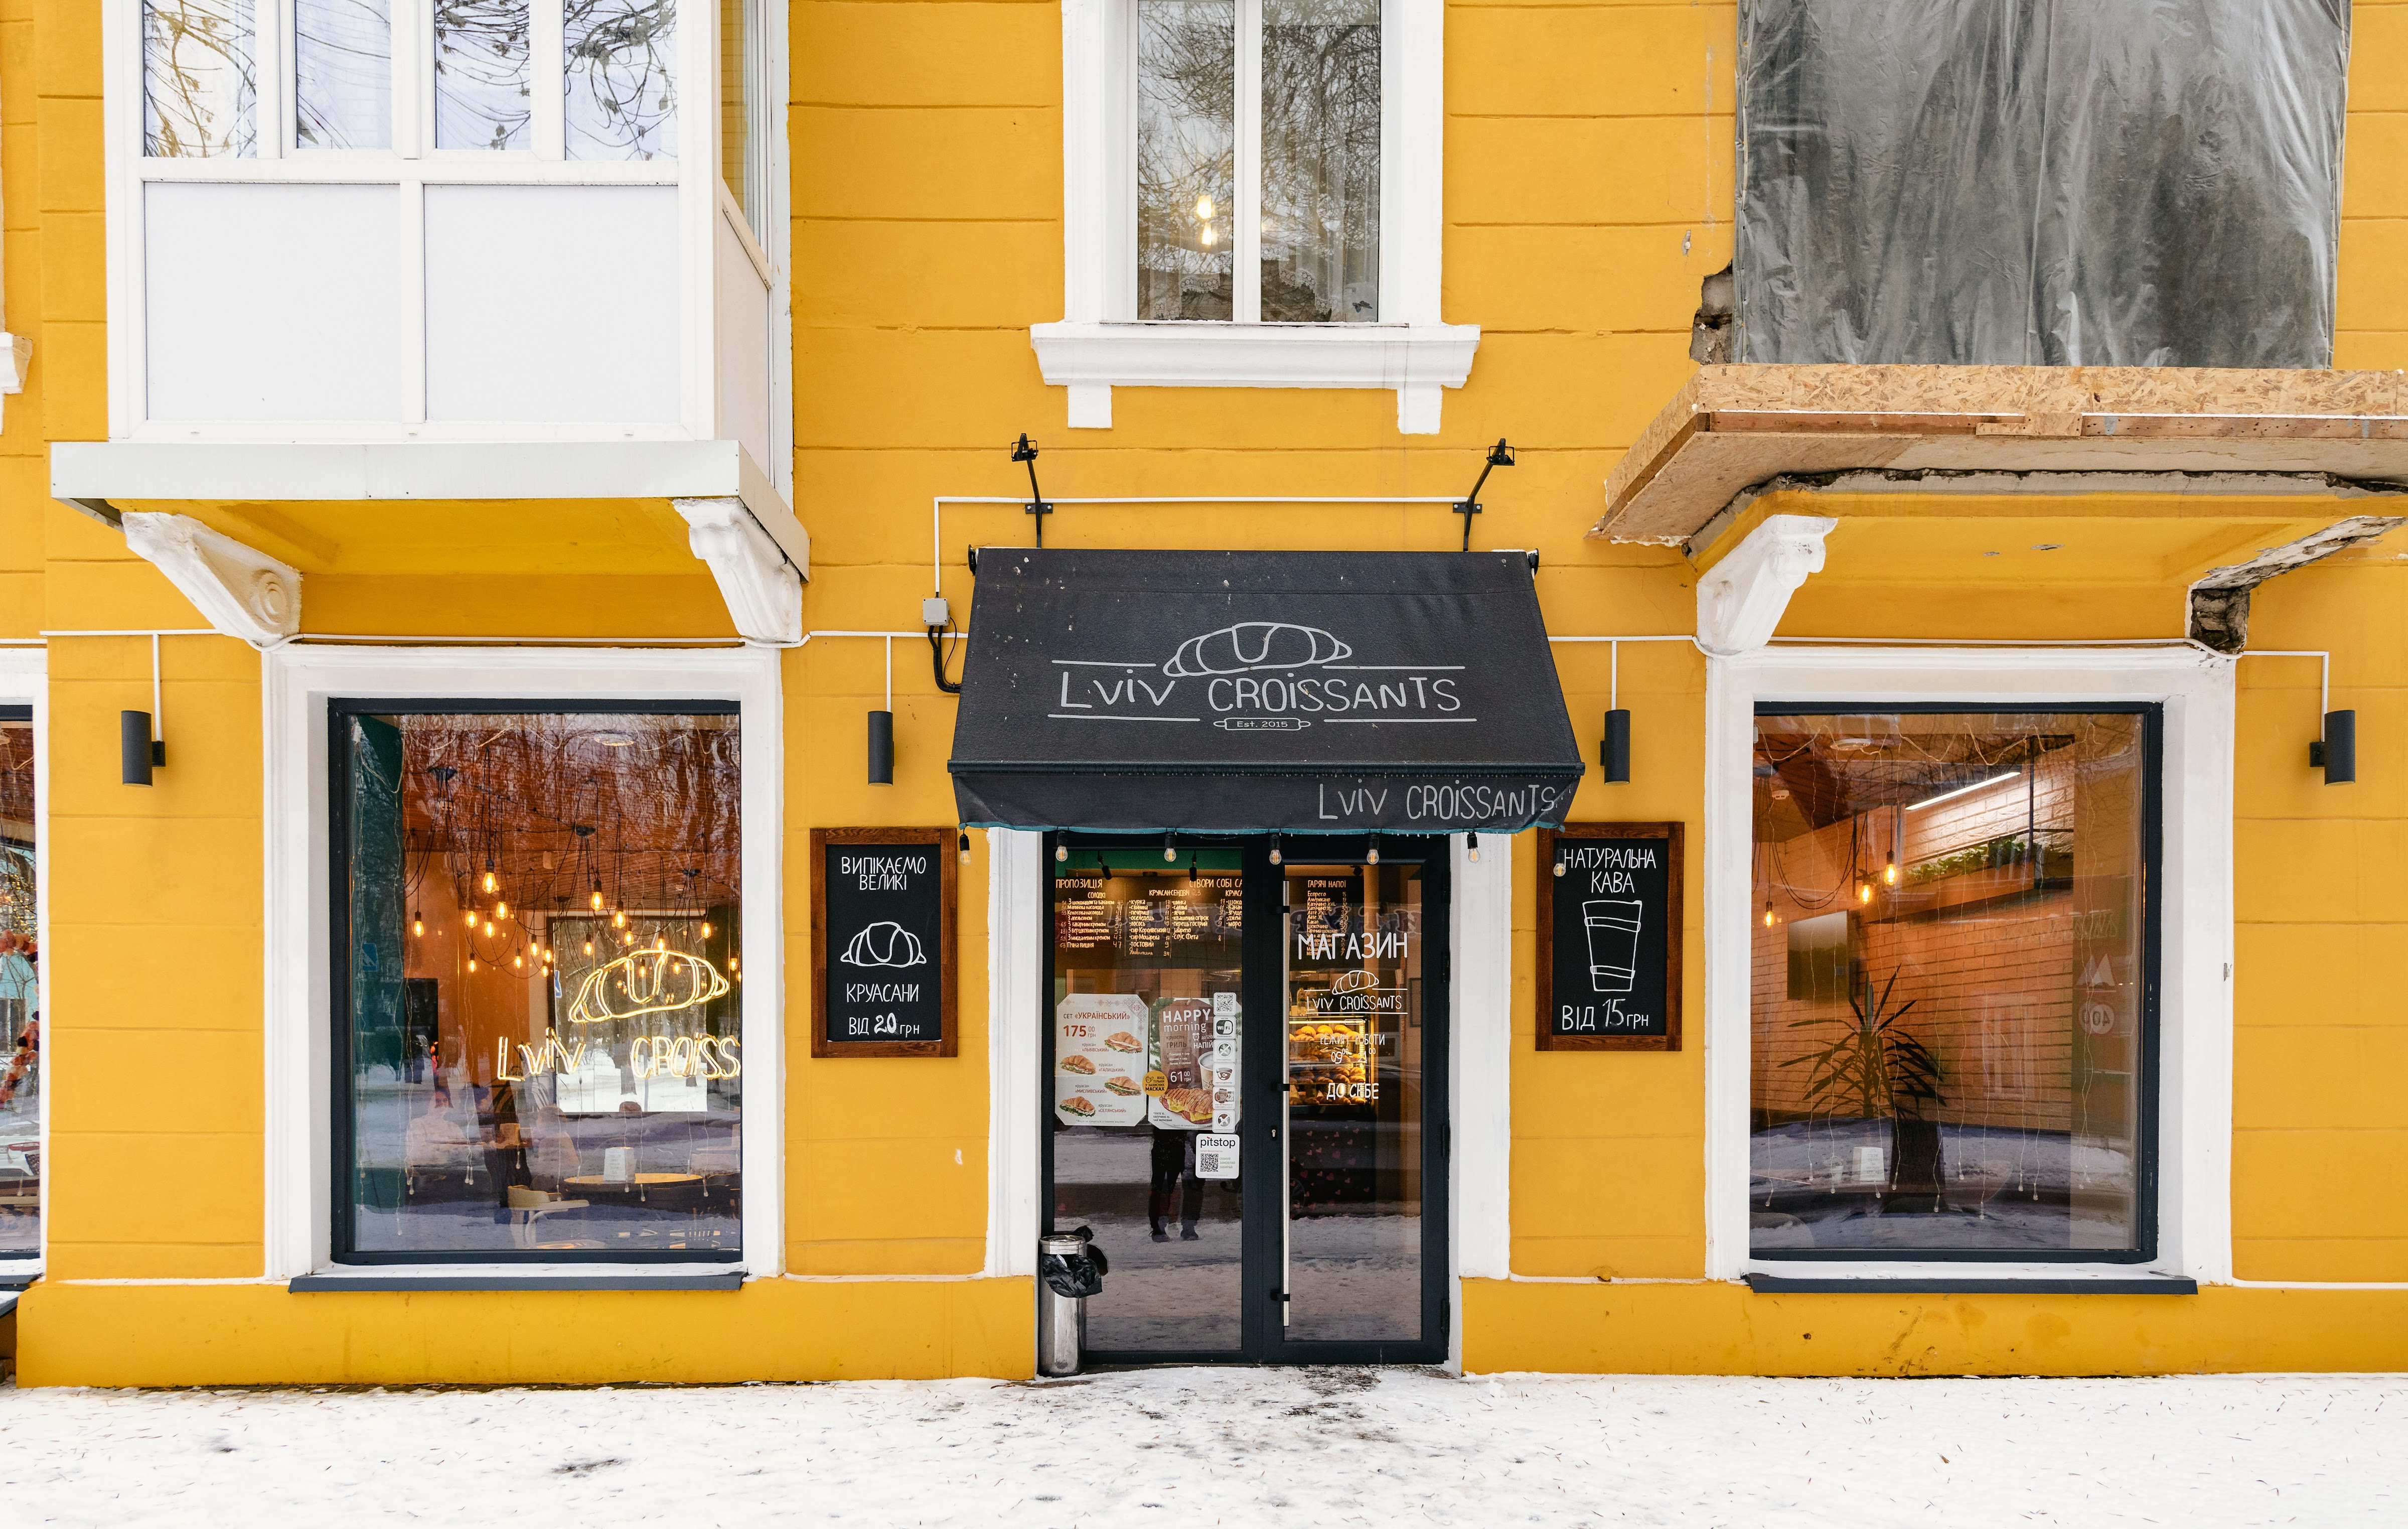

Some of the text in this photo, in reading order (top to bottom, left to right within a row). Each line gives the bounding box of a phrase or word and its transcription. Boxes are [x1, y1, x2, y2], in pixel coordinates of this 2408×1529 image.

[841, 857, 927, 874] ВИПІКАЄМО
[1564, 848, 1656, 869] НАТУРАЛЬНА
[859, 874, 907, 890] ВЕЛИКІ
[1056, 879, 1103, 889] ПРОПОЗИЦІЯ
[1217, 879, 1232, 888] СОБІ
[1591, 871, 1634, 893] КАВА
[1298, 932, 1407, 959] МАГАЗИН
[846, 983, 919, 1003] КРУАСАНИ
[1075, 1011, 1130, 1020] «УКРАЇНСЬКИЙ»
[1163, 1009, 1211, 1023] HAPPY
[1562, 1006, 1595, 1030] ВІД
[1602, 999, 1626, 1027] 15
[849, 1017, 869, 1035] ВІД
[874, 1013, 897, 1034] 20
[1064, 1025, 1086, 1037] 175
[1164, 1022, 1206, 1033] morning
[1320, 1033, 1385, 1045] РЕЖИМ РОБОТИ
[1170, 1071, 1182, 1082] 61
[1326, 1082, 1379, 1100] ДО СЕБЕ
[1200, 1137, 1235, 1149] pitstop
